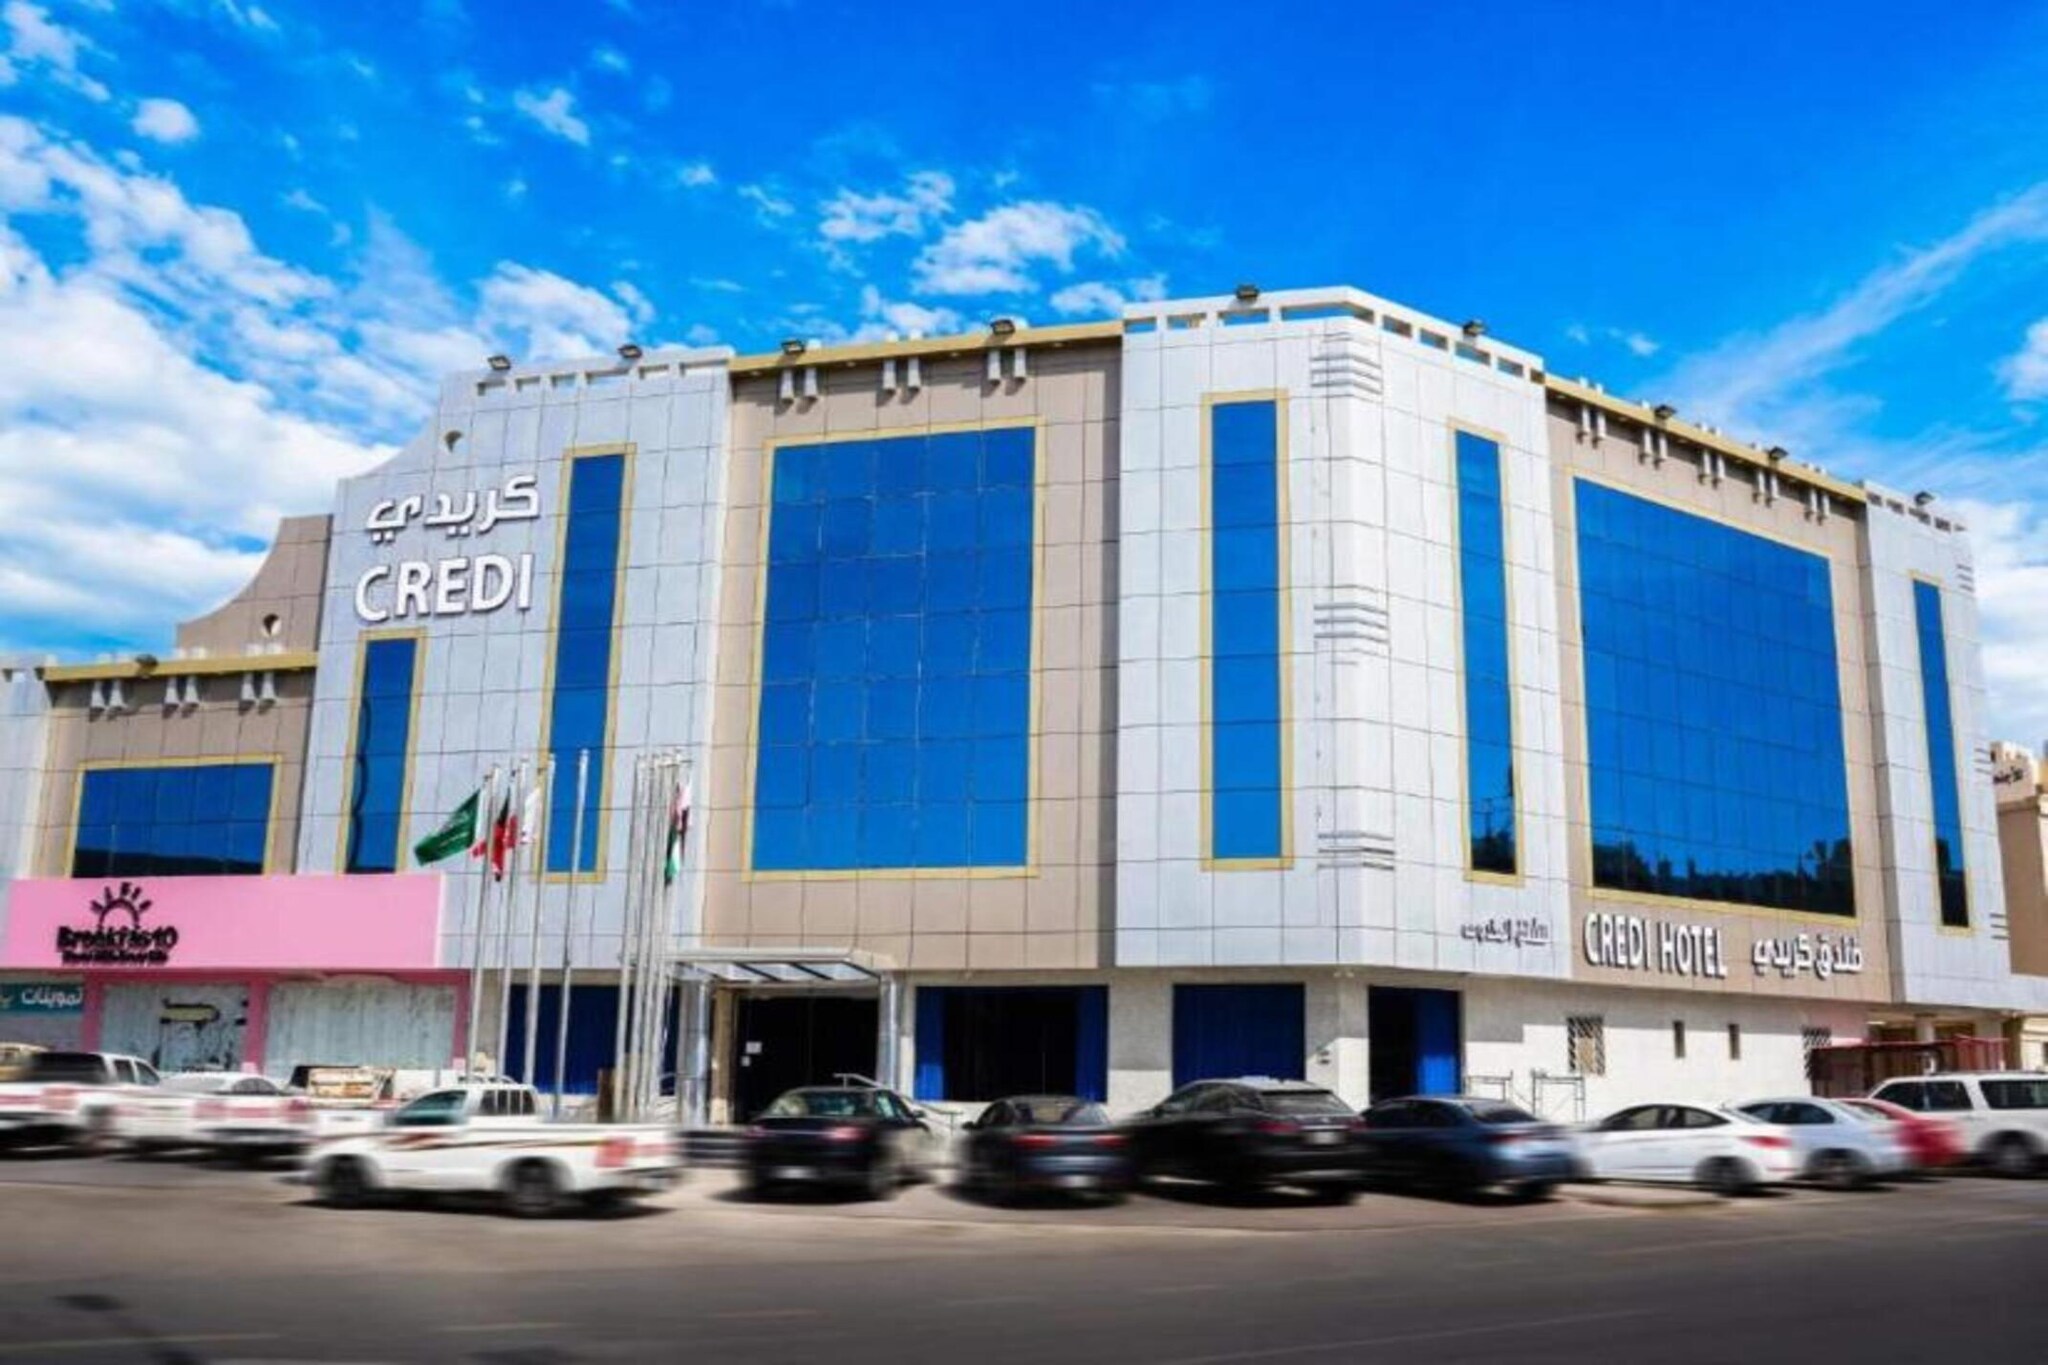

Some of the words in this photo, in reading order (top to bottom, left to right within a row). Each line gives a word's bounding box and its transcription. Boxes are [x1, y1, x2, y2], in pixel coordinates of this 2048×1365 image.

[366, 474, 541, 544] كريدي
[355, 554, 533, 624] CREDI
[1584, 912, 1651, 972] CREDI
[1658, 921, 1728, 980] HOTEL
[1752, 933, 1812, 978] كريدي
[1814, 933, 1862, 980] فندق
